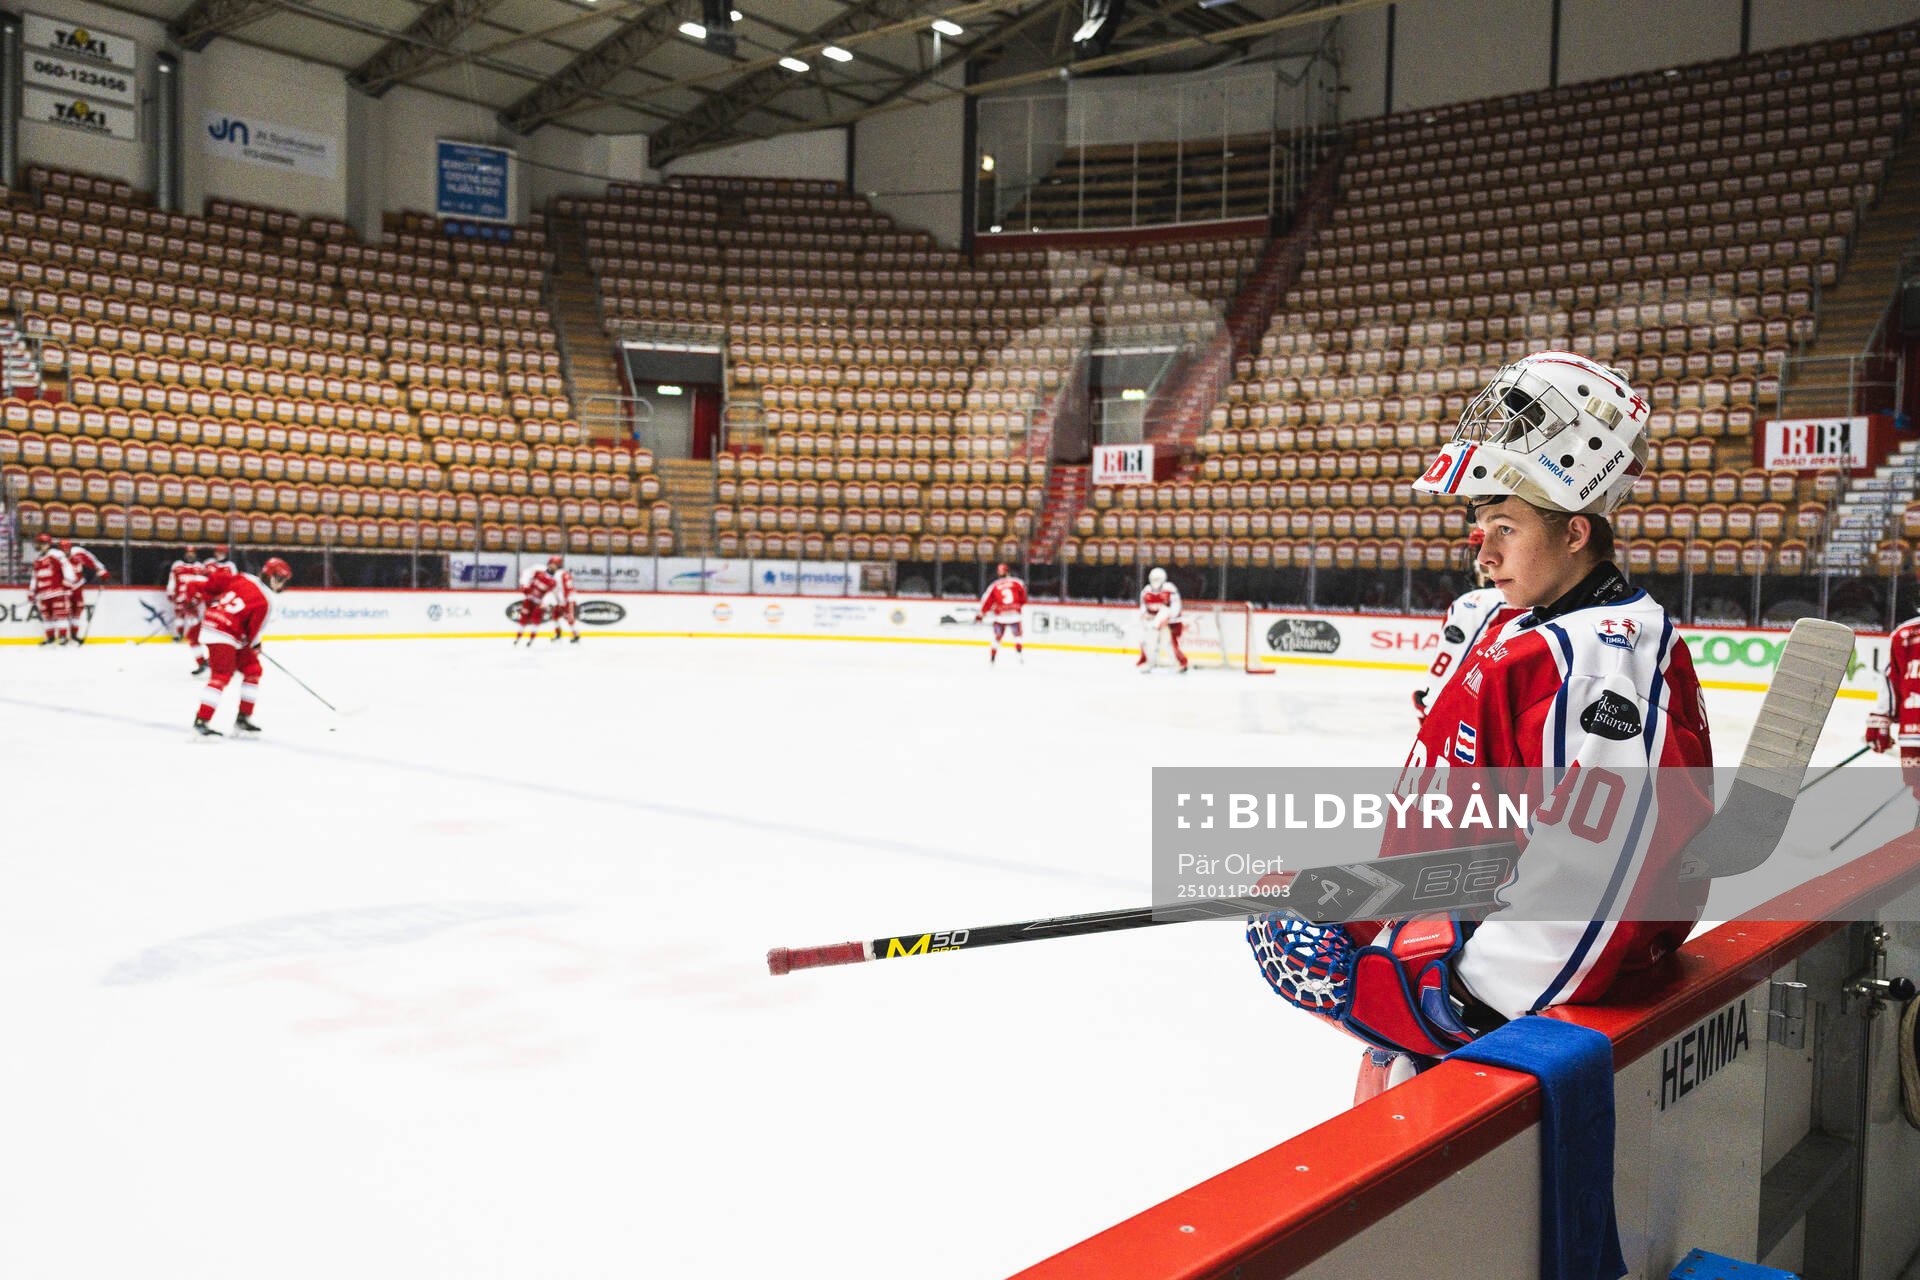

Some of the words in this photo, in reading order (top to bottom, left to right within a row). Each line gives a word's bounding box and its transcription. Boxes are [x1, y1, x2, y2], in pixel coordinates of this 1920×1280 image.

[54, 29, 107, 55] TAXI
[54, 102, 106, 127] TAXI
[1579, 449, 1626, 501] BAUER
[1001, 589, 1015, 605] 3
[1430, 651, 1453, 677] 8
[1660, 999, 1748, 1112] HEMMA
